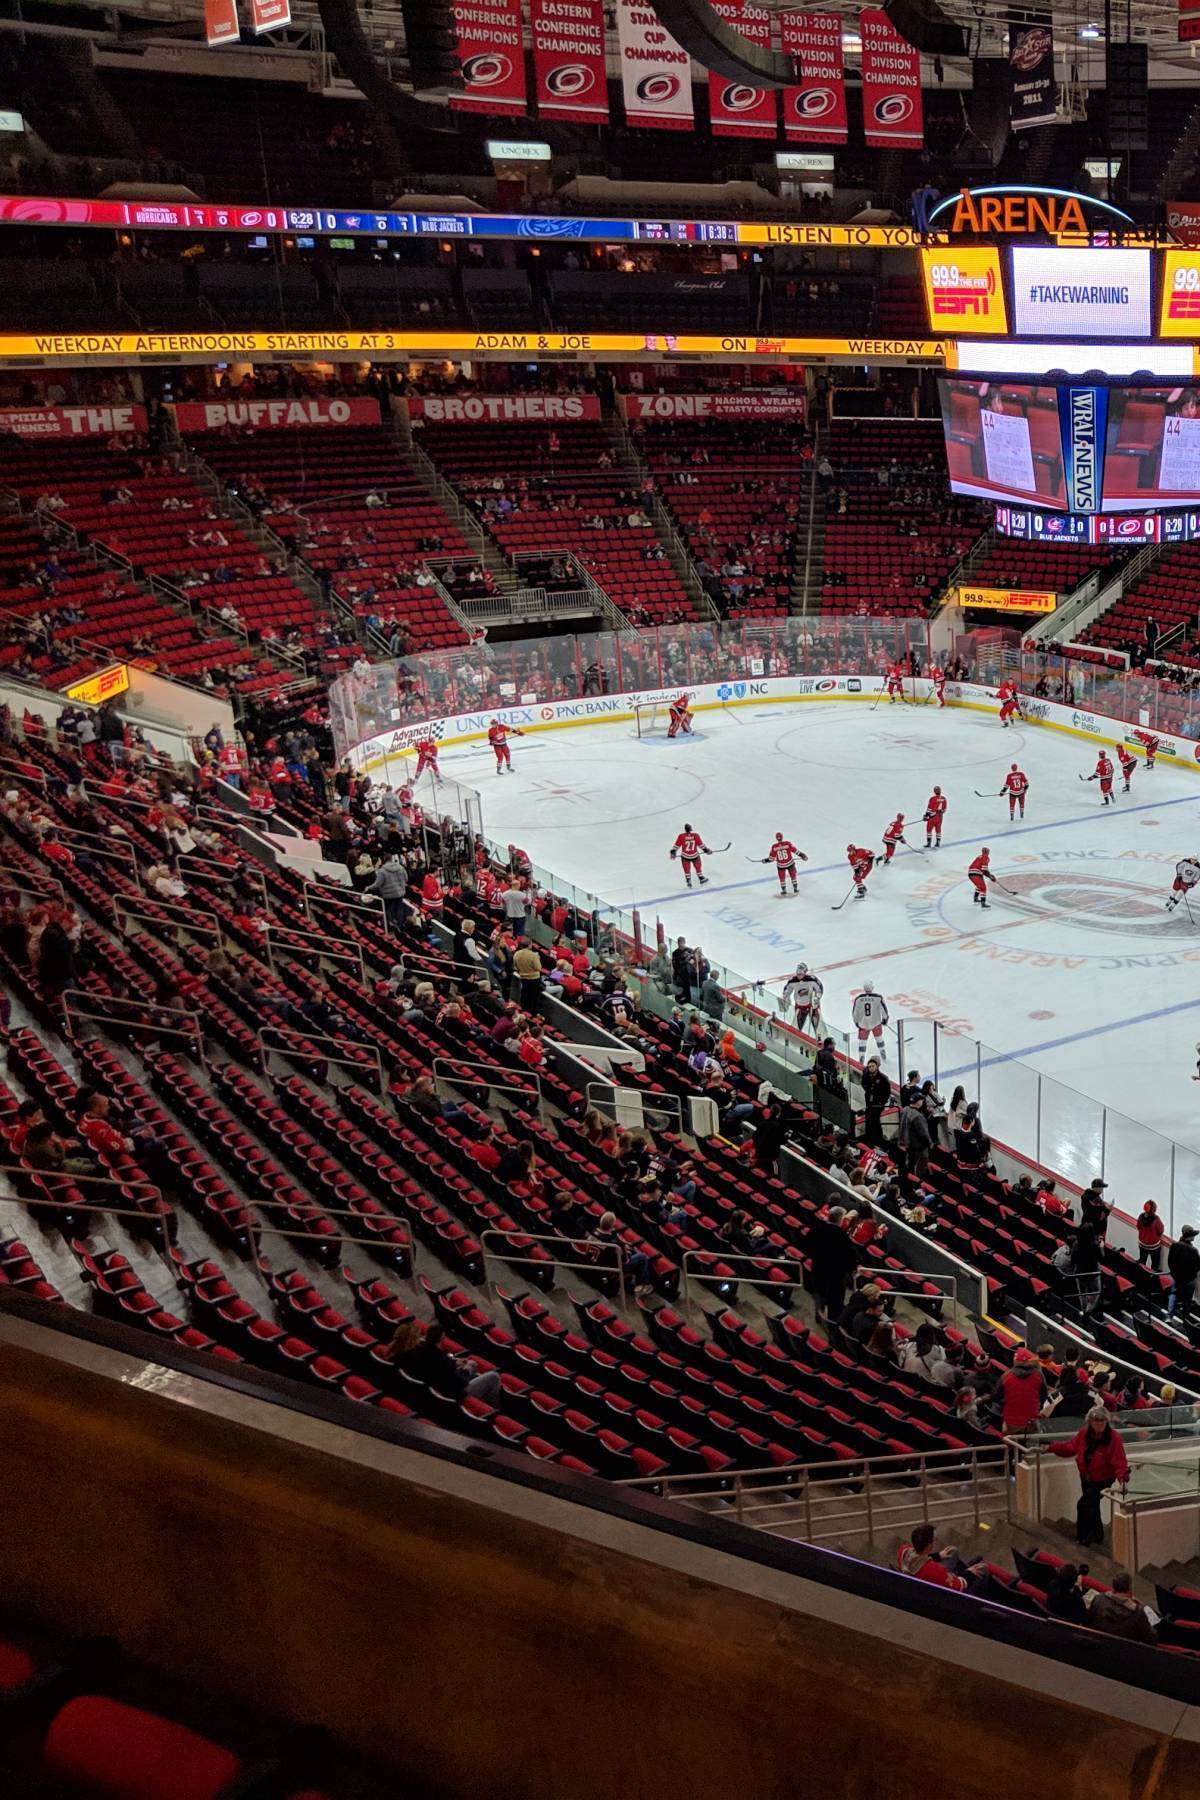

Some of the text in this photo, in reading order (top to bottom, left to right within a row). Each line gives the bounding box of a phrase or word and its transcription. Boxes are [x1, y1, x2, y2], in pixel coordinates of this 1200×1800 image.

[453, 7, 517, 27] ONFERENCE
[542, 3, 592, 19] EASTERN
[535, 18, 600, 38] CONFERENCE
[784, 14, 839, 31] 2001-2002
[455, 27, 518, 45] HAMPIONS
[644, 31, 667, 44] CUP
[784, 30, 840, 47] SOUTHEAST
[536, 37, 601, 56] CHAMPIONS
[865, 40, 916, 55] SOUTHEAST
[625, 47, 688, 64] CHAMPIONS
[871, 56, 912, 70] DIVISION
[794, 66, 842, 80] AMPIONS
[865, 72, 917, 86] CHAMPIONS
[788, 158, 824, 167] UNC REX
[136, 212, 178, 224] HURRICANES
[952, 188, 1087, 232] ARENA
[219, 216, 227, 225] 0
[267, 213, 277, 227] 0
[290, 213, 314, 225] 6:28
[326, 215, 336, 229] 0
[378, 222, 387, 230] 0
[422, 221, 465, 233] BLUE JACKETS
[767, 226, 871, 245] LISTEN TO
[931, 265, 959, 287] 99.9
[959, 279, 973, 287] THE
[933, 289, 989, 314] ESPN
[1029, 285, 1130, 305] #TAKEWARNING
[35, 335, 394, 352] WEEKDAY AFTERNOONS STARTING AT 3
[475, 336, 591, 349] ADAM & JOE
[721, 338, 747, 351] ON
[849, 341, 925, 354] WEEKDAY
[424, 398, 584, 420] BROTHERS
[638, 396, 712, 417] ZONE
[715, 396, 802, 406] NACHOS, WRAPS
[63, 408, 135, 433] THE
[204, 401, 350, 428] BUFFALO
[984, 413, 996, 431] 44
[1167, 419, 1181, 438] 44
[1072, 391, 1095, 510] WRAL NEWS
[1011, 512, 1026, 529] 6:28
[1034, 515, 1043, 531] 0
[1145, 518, 1154, 535] 0
[1165, 517, 1183, 533] 6:28
[1039, 534, 1079, 543] BLUE JACKETS
[964, 593, 983, 604] 99.9
[1009, 593, 1049, 607] ESPN
[750, 683, 769, 695] NC
[557, 698, 621, 719] PNC BANK
[456, 708, 535, 733] UNC REX
[1081, 712, 1095, 724] DUKE
[392, 726, 429, 742] Advance
[1081, 720, 1102, 734] ENERGY
[389, 742, 406, 753] Auto
[1013, 779, 1023, 789] 13
[685, 840, 696, 851] 27
[1040, 849, 1110, 861] PNC
[905, 901, 941, 928] PNC
[704, 907, 806, 954] UNC REX
[958, 939, 1184, 970] PNC ARENA
[864, 1003, 871, 1017] 8
